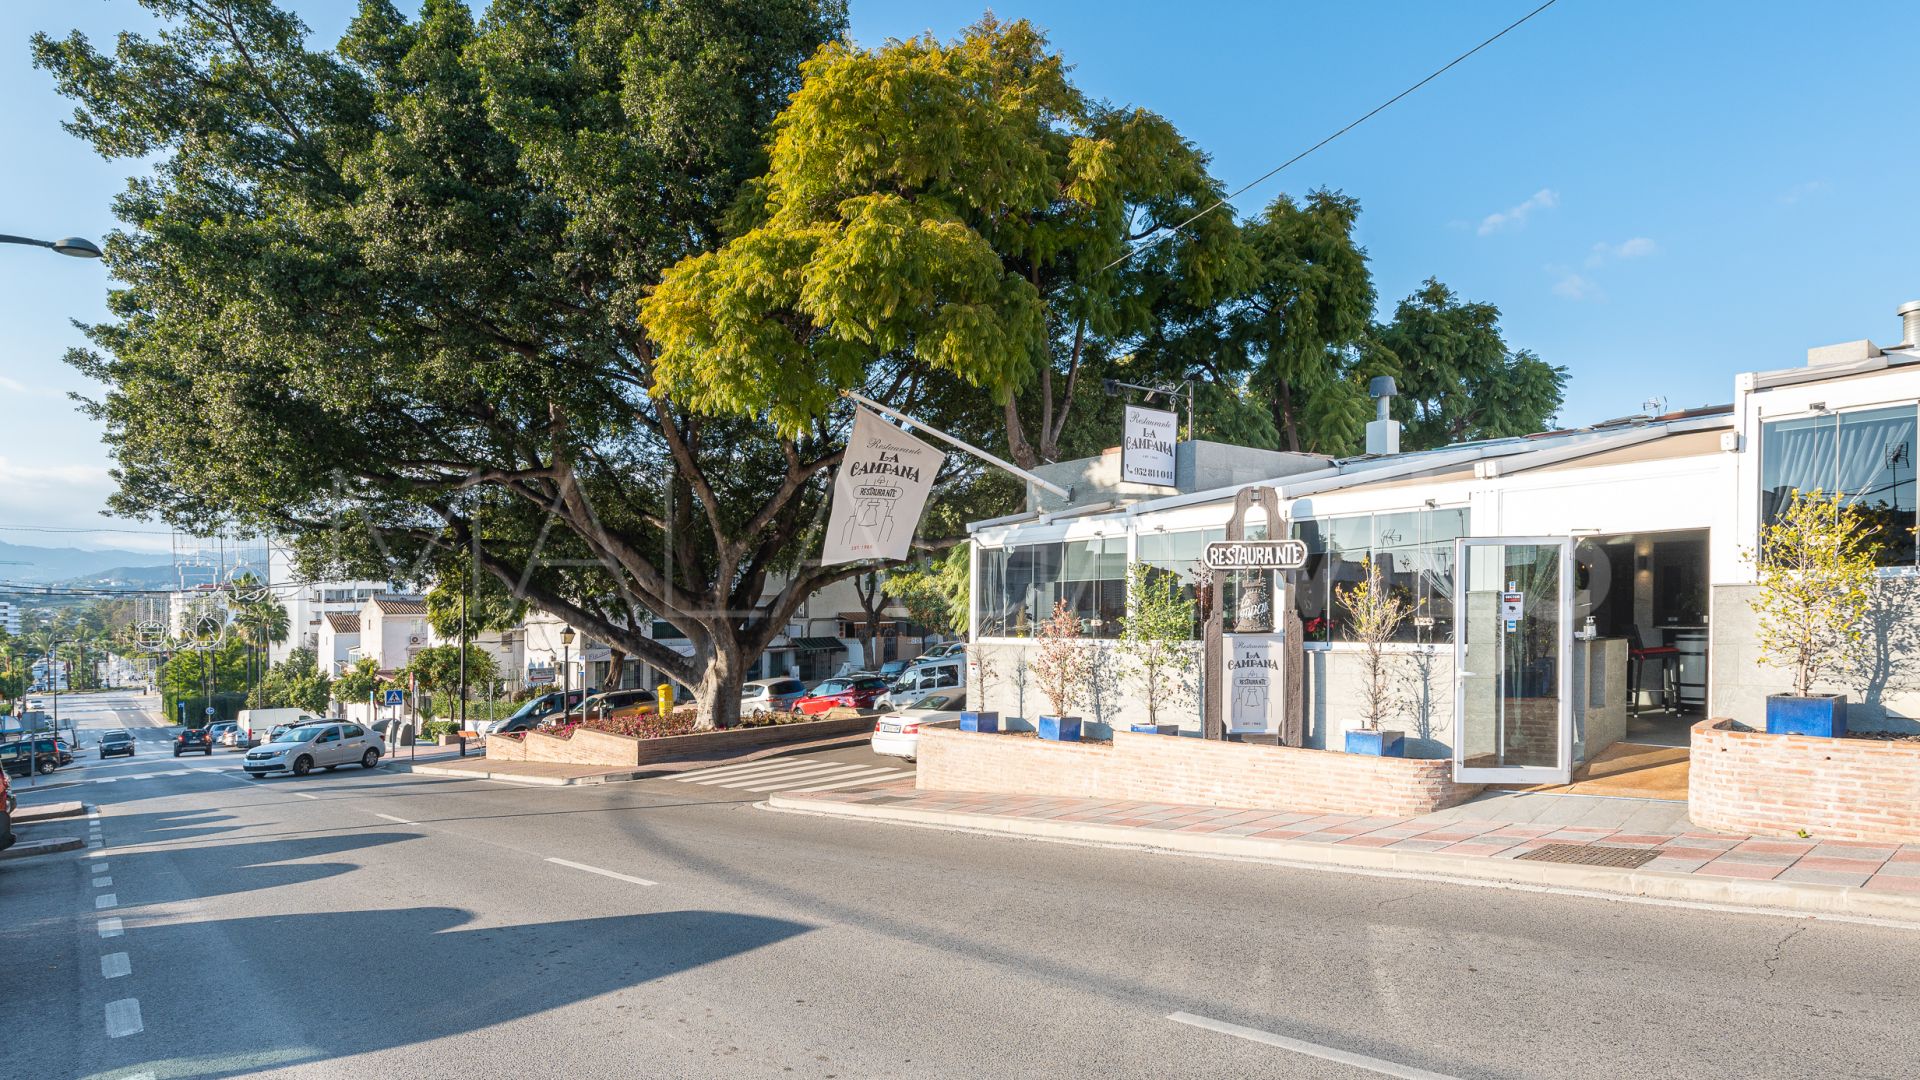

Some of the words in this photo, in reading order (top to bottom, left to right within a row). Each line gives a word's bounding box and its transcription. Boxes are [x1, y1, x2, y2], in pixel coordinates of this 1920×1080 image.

[1130, 411, 1171, 427] Restaurante
[1143, 428, 1156, 438] LA
[866, 438, 922, 455] Restaurante
[1125, 436, 1173, 457] CAMPANA
[878, 451, 899, 462] LA
[851, 461, 919, 482] CAMPANA
[859, 486, 898, 498] RESTAURANTE
[1210, 545, 1302, 565] RESTAURANTE
[1246, 651, 1260, 659] LA
[1227, 659, 1279, 671] CAMPANA
